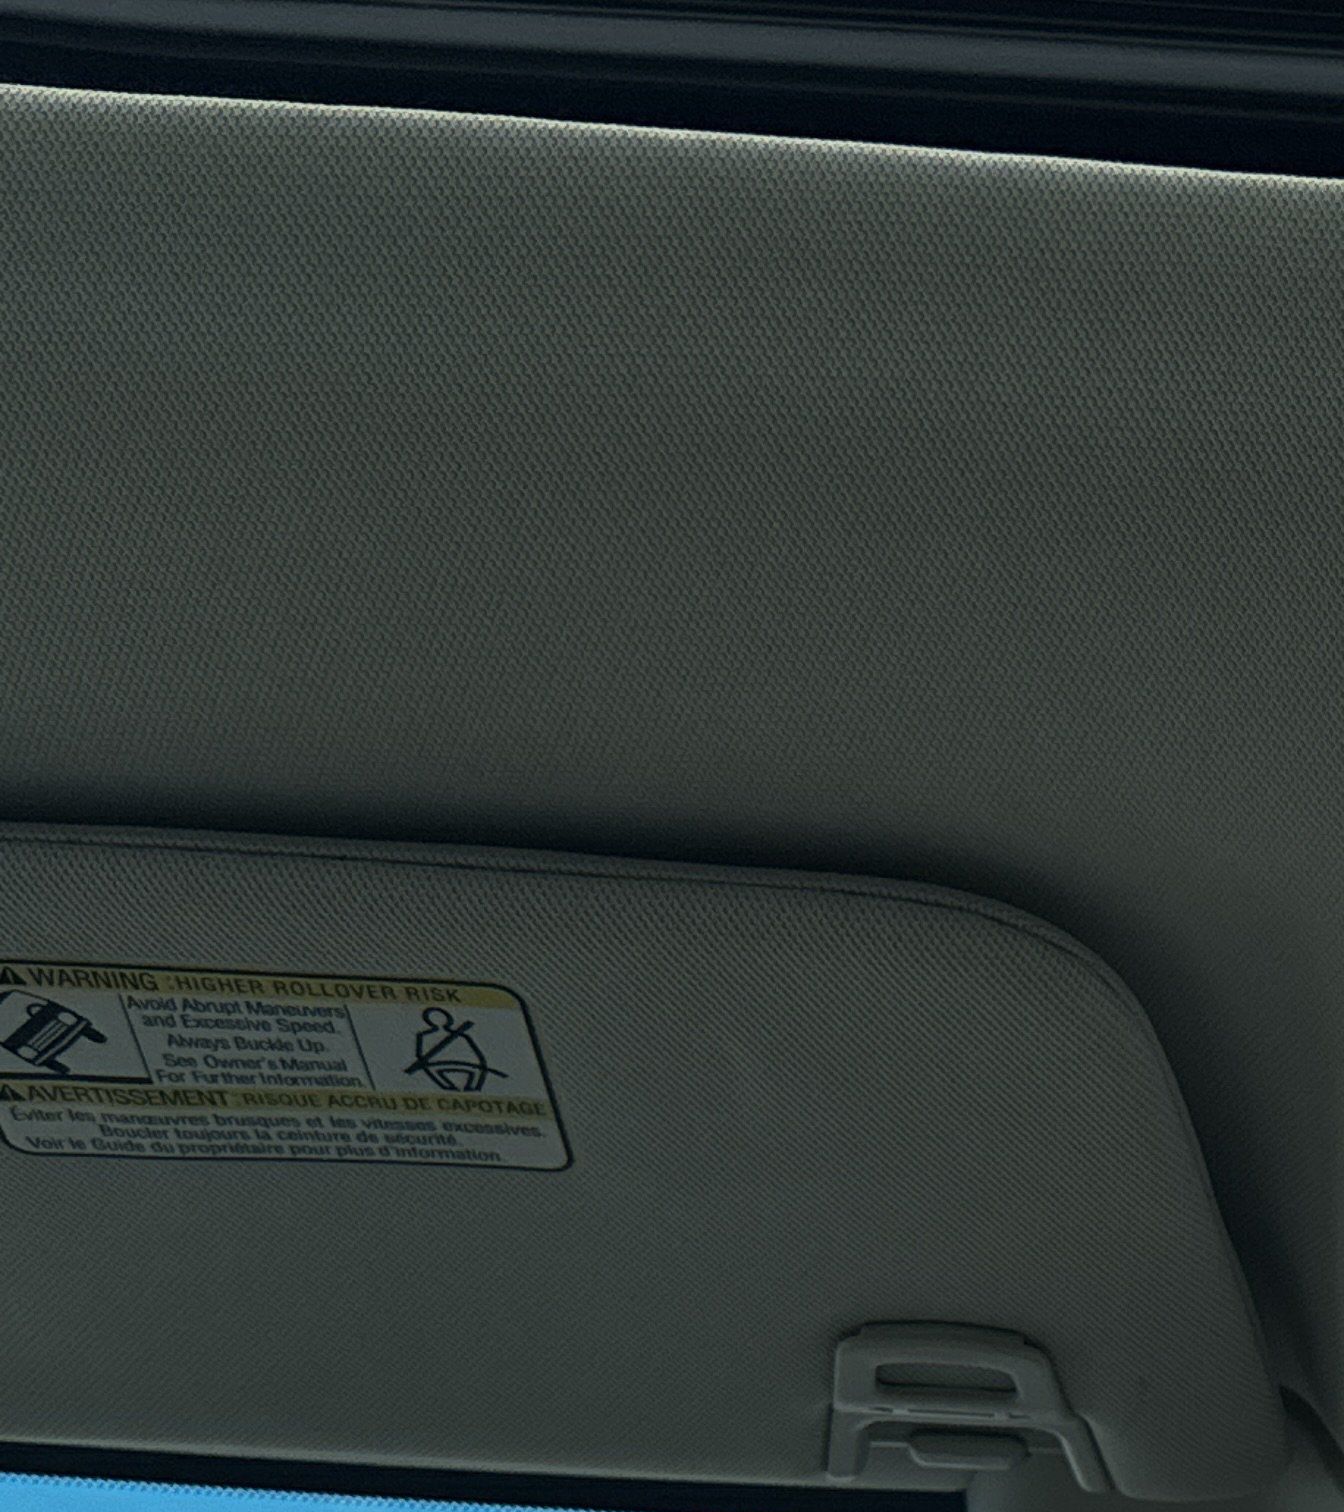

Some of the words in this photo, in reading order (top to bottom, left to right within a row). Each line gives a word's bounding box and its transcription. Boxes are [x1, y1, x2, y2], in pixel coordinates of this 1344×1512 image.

[28, 968, 158, 991] WARNING
[177, 977, 263, 994] HIGHER
[274, 980, 396, 999] ROLLOVER
[406, 987, 461, 1002] RISK
[127, 995, 176, 1011] Avoid
[182, 998, 242, 1015] Abrupt
[245, 1001, 346, 1018] Maneuvers
[142, 1014, 176, 1028] and
[181, 1014, 272, 1032] Excessive
[168, 1034, 230, 1051] Always
[234, 1036, 294, 1052] Buckle
[163, 1054, 197, 1067] See
[204, 1054, 278, 1069] Owner's
[280, 1057, 347, 1072] Manual
[156, 1069, 184, 1082] For
[191, 1070, 255, 1084] Further
[28, 1085, 227, 1106] AVERTISSEMENT
[242, 1092, 322, 1107] RISQUE
[327, 1094, 396, 1110] ACCRU
[403, 1097, 430, 1110] DE
[437, 1098, 547, 1116] CAPOTAGE
[68, 1108, 96, 1121] les
[213, 1113, 300, 1129] brusques
[306, 1116, 324, 1128] et
[330, 1116, 357, 1129] les
[99, 1124, 169, 1139] Boucler
[174, 1127, 250, 1142] toujours
[254, 1128, 272, 1141] la
[356, 1131, 378, 1144] de
[26, 1136, 64, 1150] Voir
[69, 1137, 86, 1150] le
[90, 1137, 145, 1152] Guide
[151, 1139, 175, 1153] du
[289, 1144, 331, 1157] pour
[336, 1144, 374, 1158] plus
